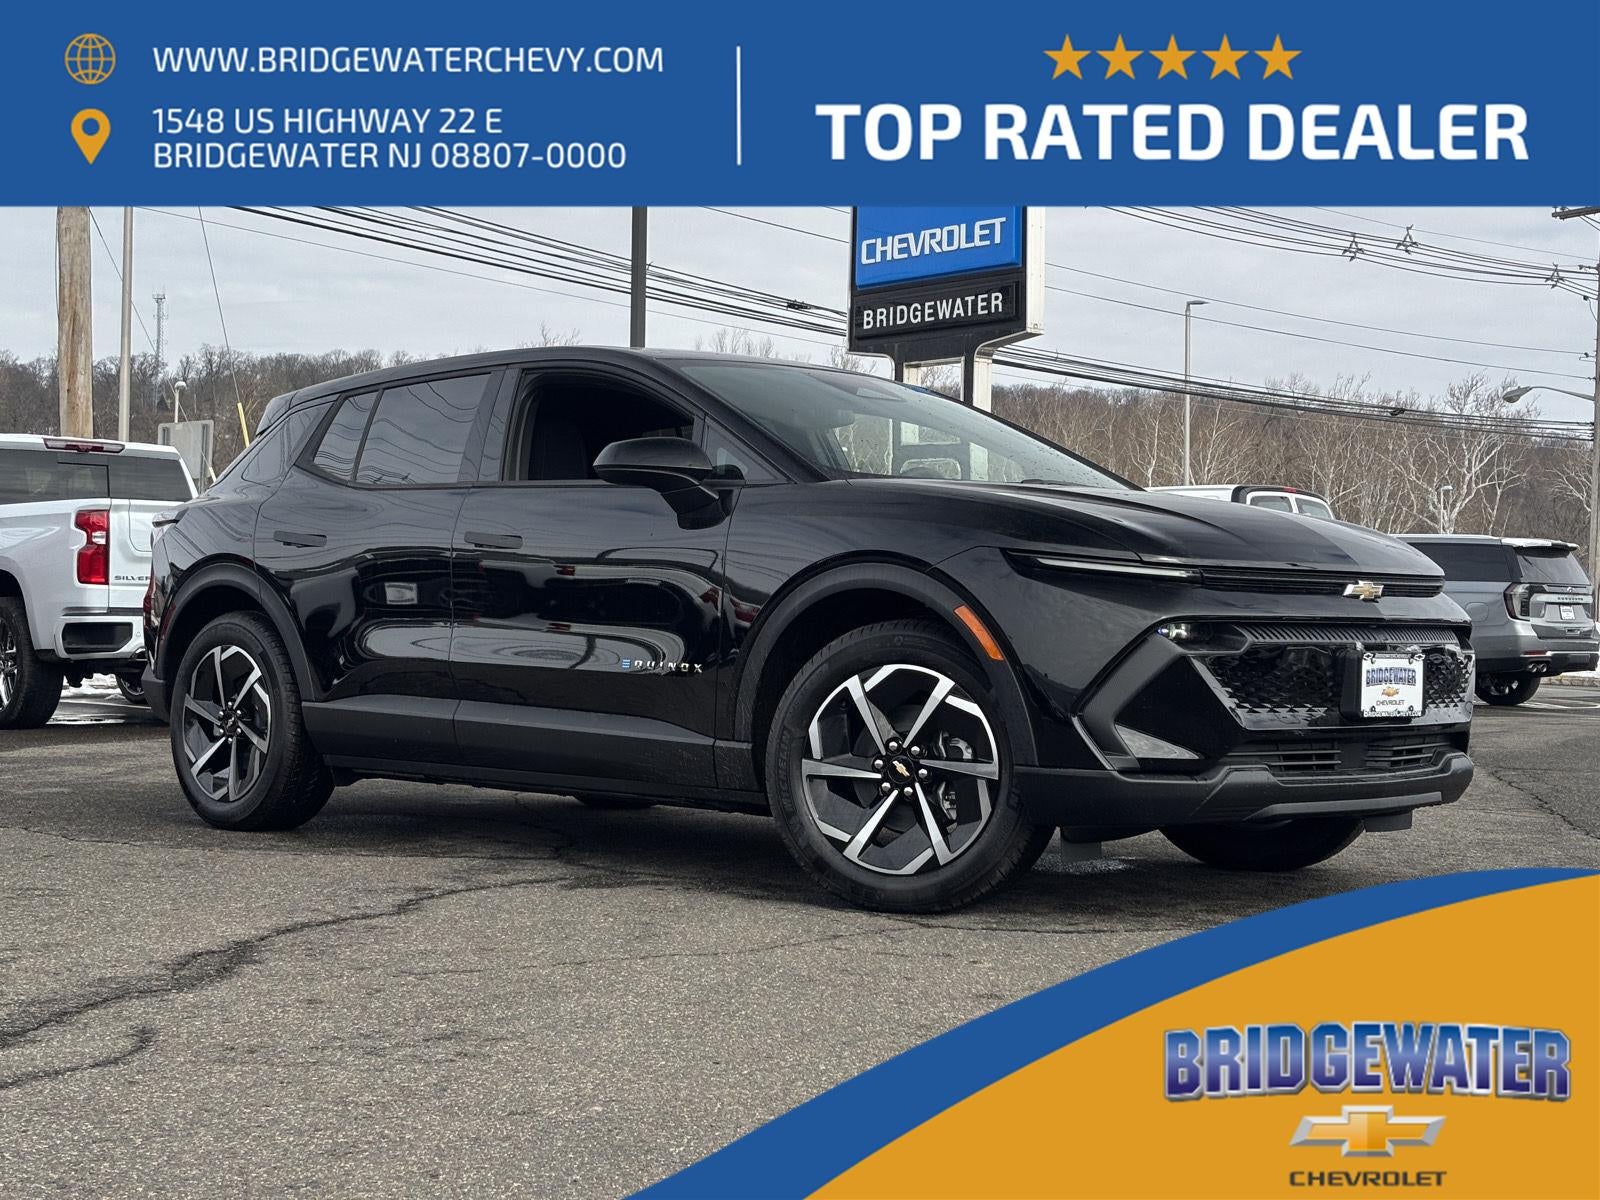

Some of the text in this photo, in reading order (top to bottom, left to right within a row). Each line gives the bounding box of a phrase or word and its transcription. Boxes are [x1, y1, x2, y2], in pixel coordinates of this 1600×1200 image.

[861, 217, 1006, 265] CHEVROLET
[863, 292, 1003, 330] BRIDGEWATER
[622, 659, 703, 673] EQUINOX
[1366, 667, 1417, 687] BRIDGEWATER
